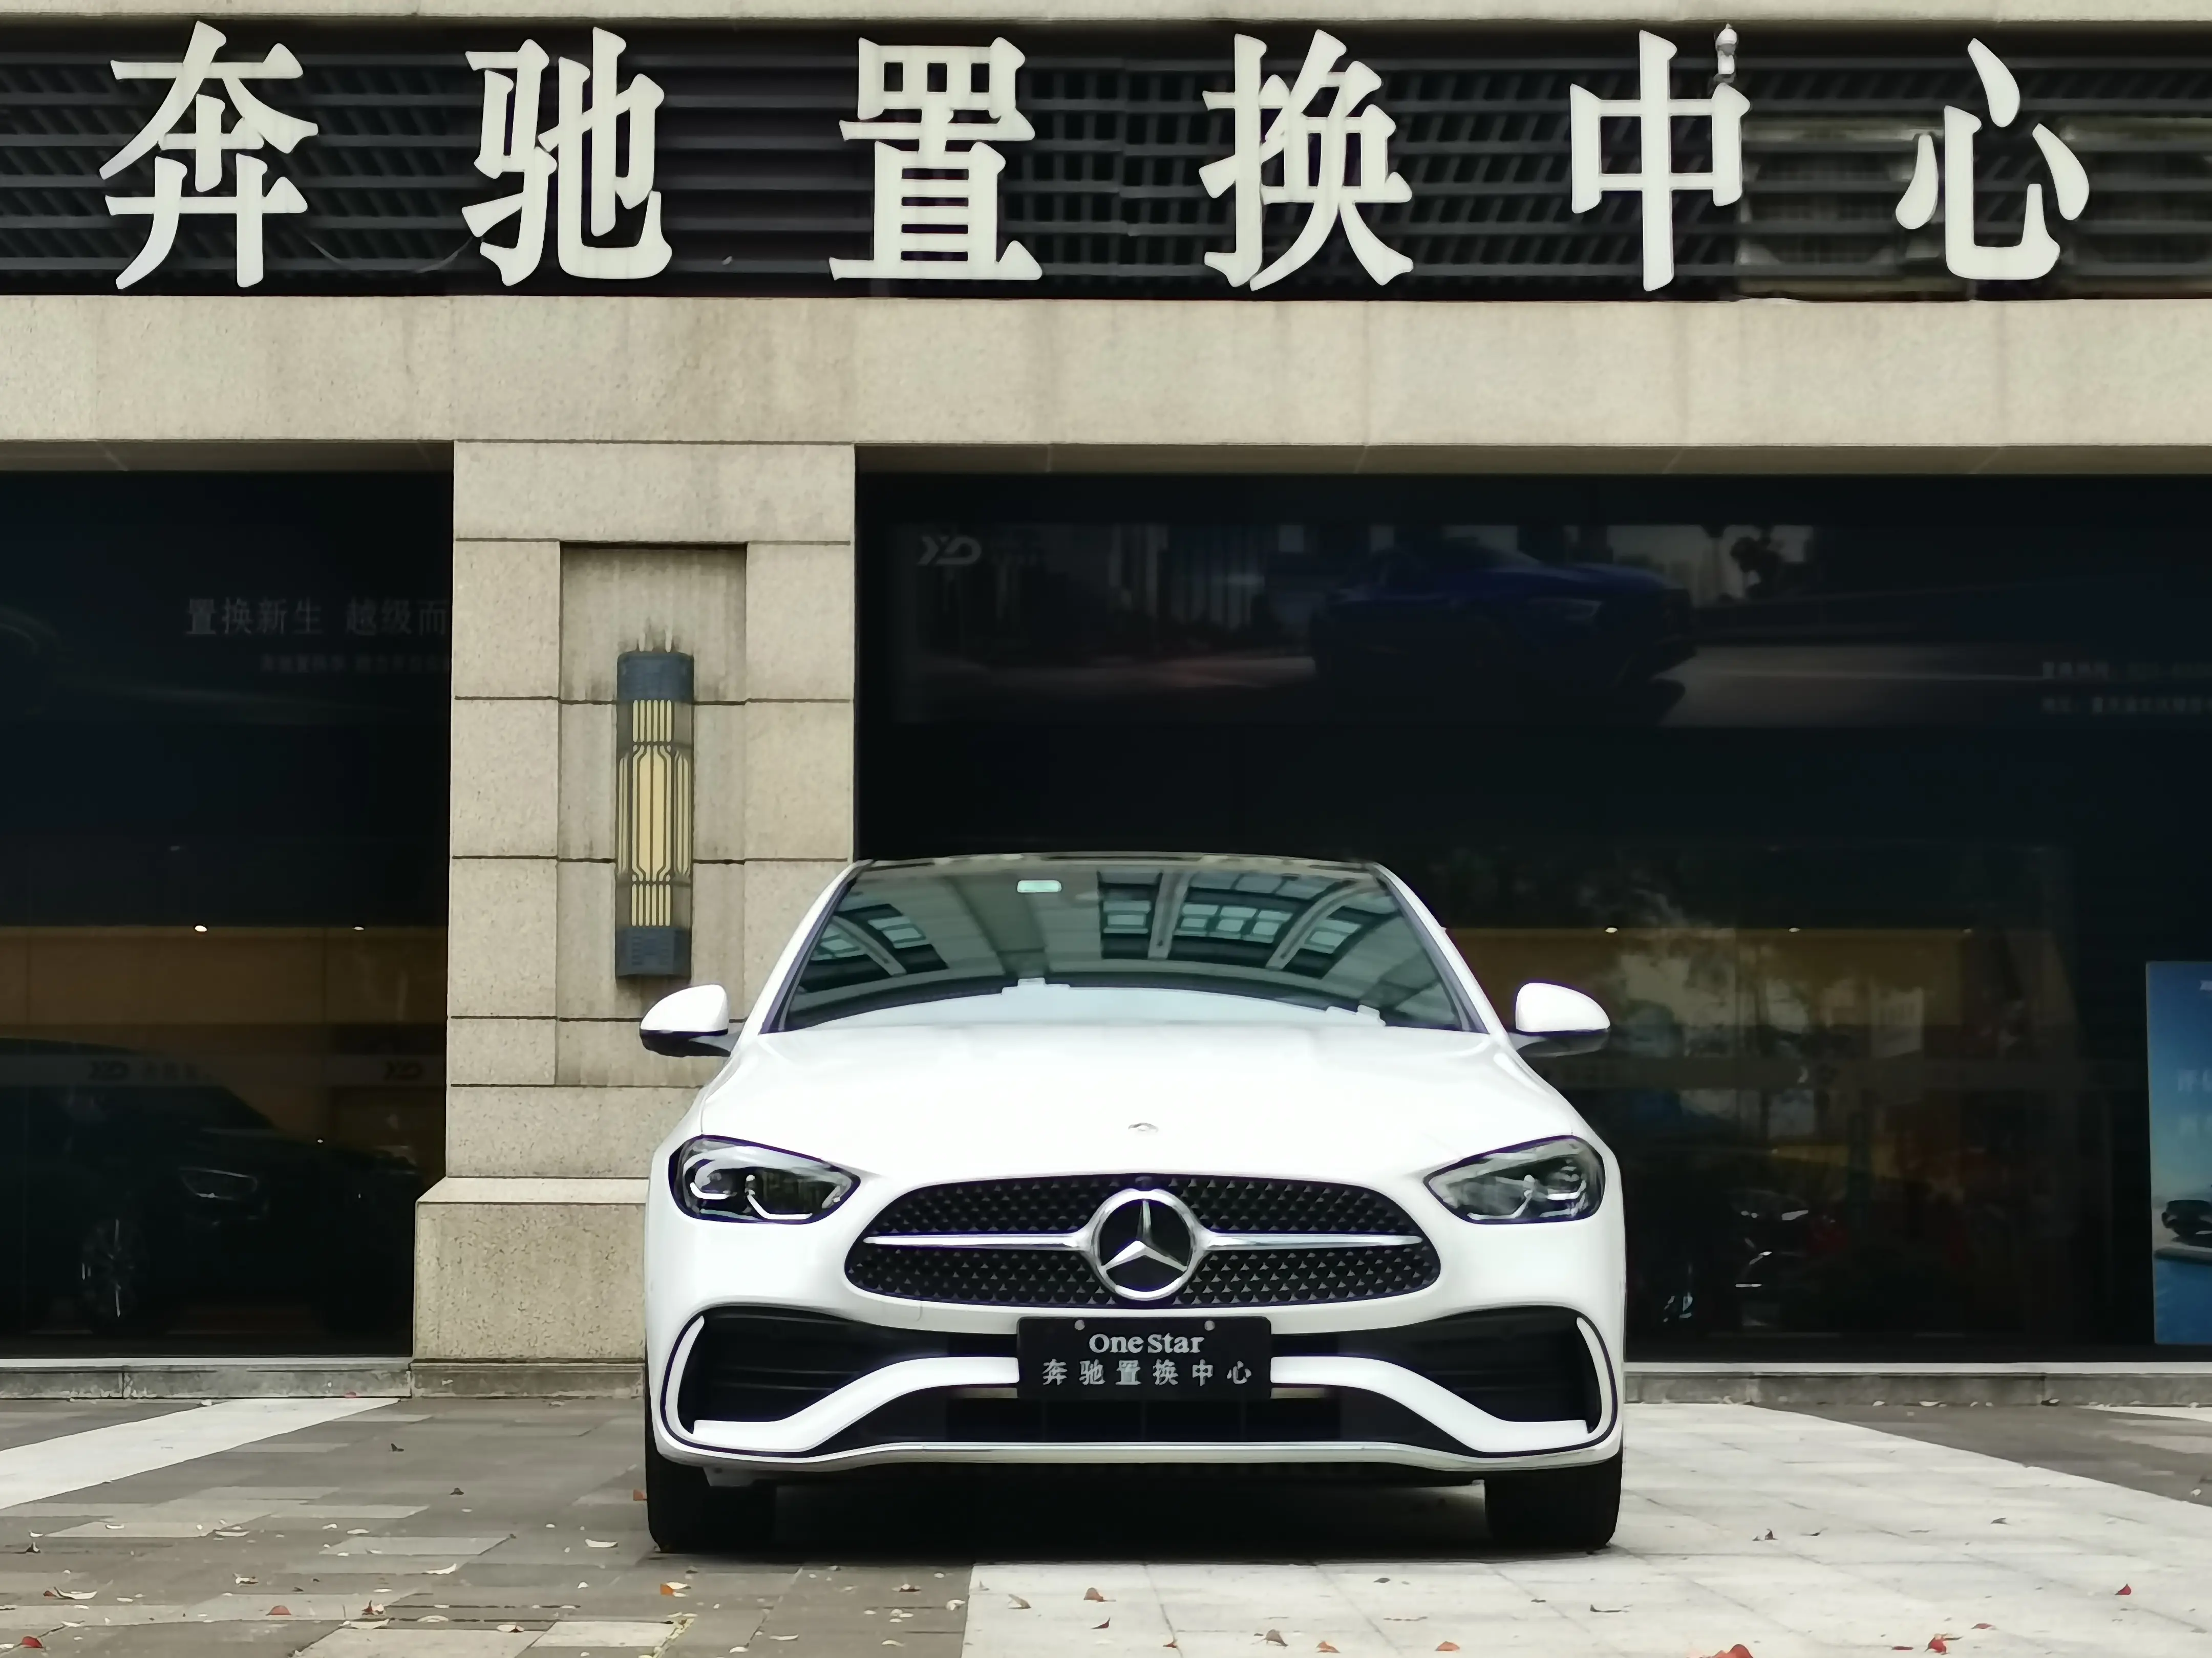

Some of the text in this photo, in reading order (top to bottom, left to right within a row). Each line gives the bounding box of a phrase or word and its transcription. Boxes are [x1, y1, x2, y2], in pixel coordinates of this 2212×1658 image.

[100, 20, 2089, 291] 奔驰置换中心
[186, 597, 323, 636] 置换新生
[1043, 1359, 1252, 1386] 奔驰置换中心
